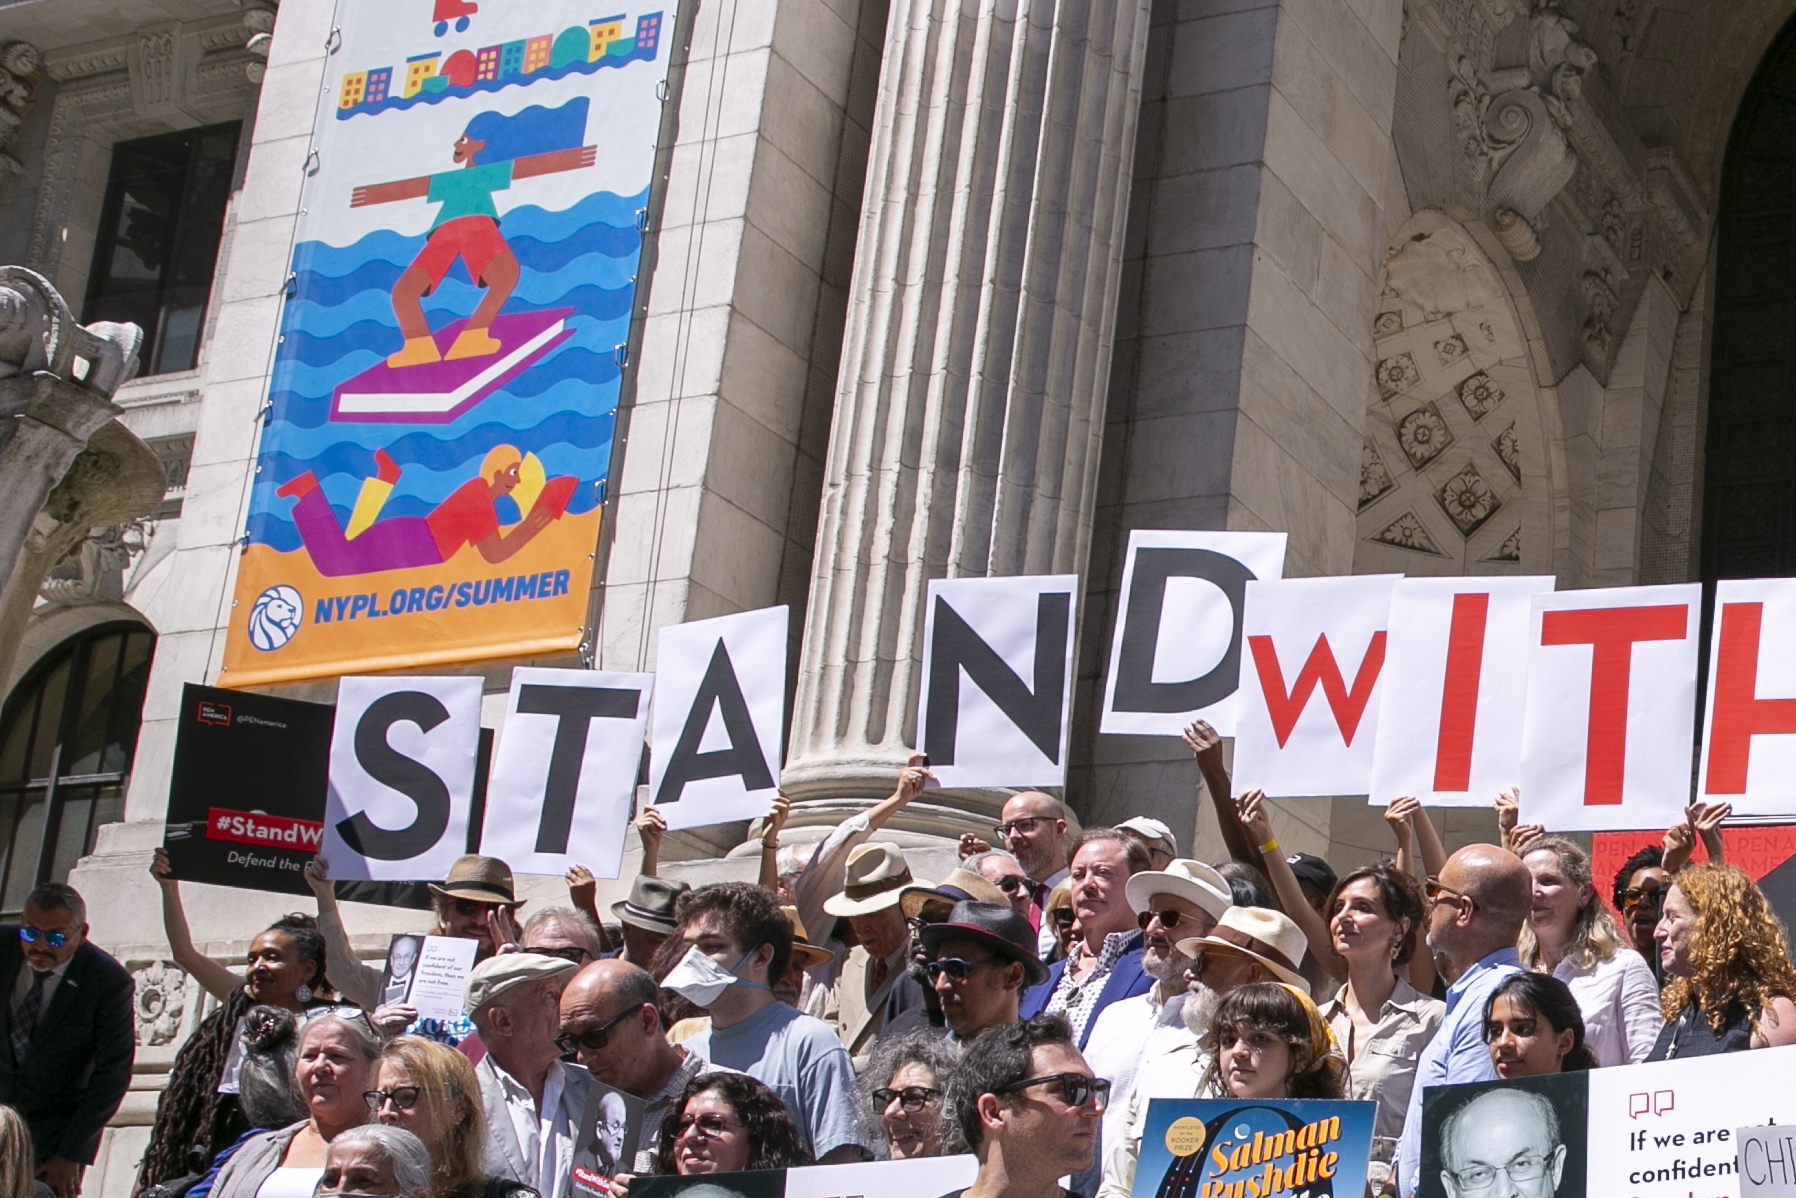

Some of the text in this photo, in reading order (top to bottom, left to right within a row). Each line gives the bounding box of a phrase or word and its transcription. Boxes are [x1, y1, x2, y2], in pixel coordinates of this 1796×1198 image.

[314, 568, 570, 624] NYPL.ORG/SUMMER
[202, 712, 228, 720] AMERICA
[236, 715, 287, 729] @PENamerica
[227, 851, 300, 871] Defend the
[1208, 1115, 1341, 1178] Salman
[1630, 1128, 1730, 1151] If we are
[1629, 1155, 1740, 1184] confident
